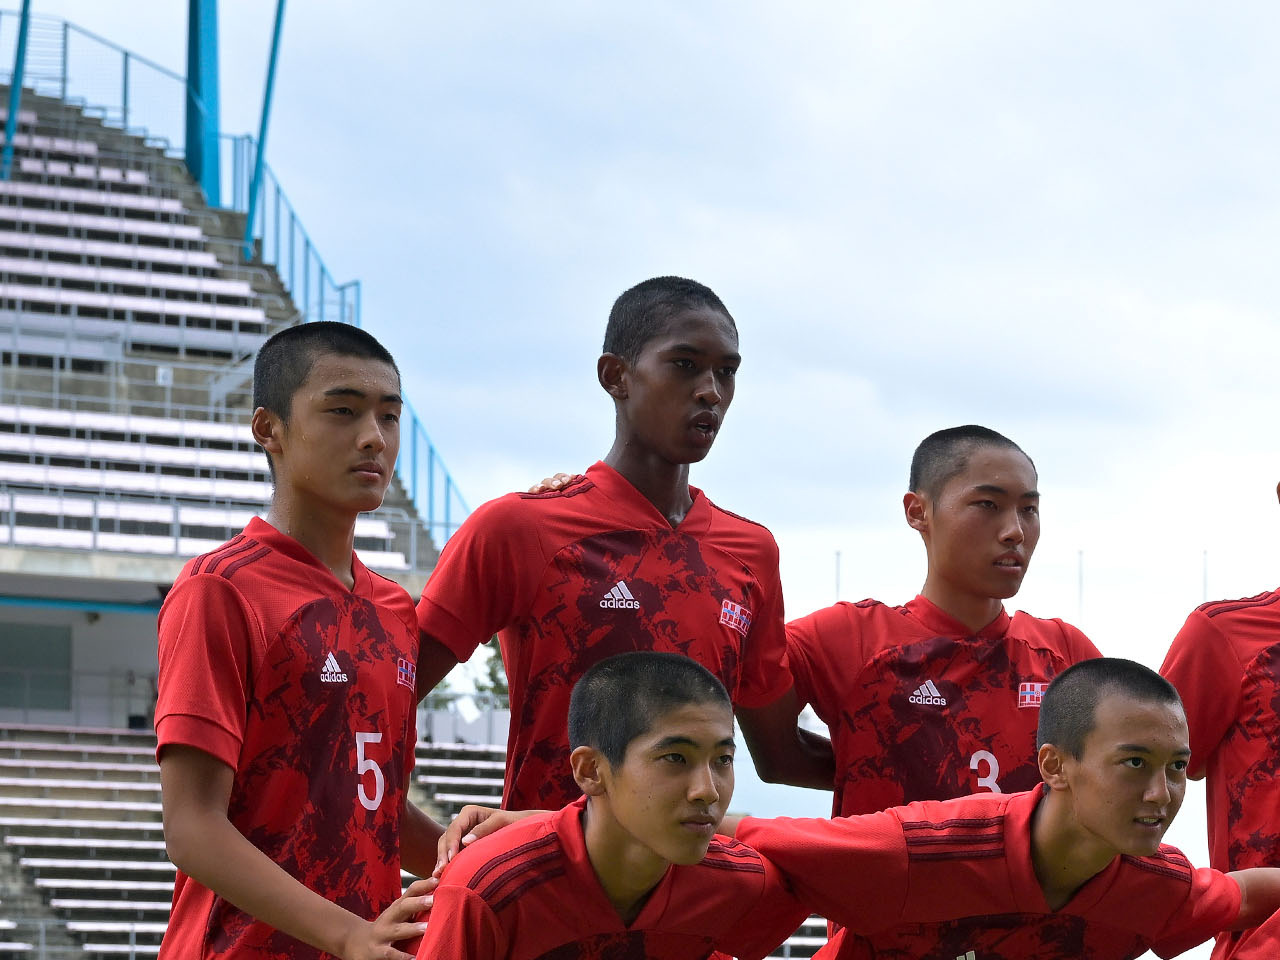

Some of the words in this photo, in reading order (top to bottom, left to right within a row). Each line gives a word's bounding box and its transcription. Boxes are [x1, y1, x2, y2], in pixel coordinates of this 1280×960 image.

[599, 598, 640, 610] adidas
[320, 671, 348, 684] adidas
[909, 693, 947, 707] adidas
[355, 731, 385, 811] 5
[969, 749, 1002, 794] 3
